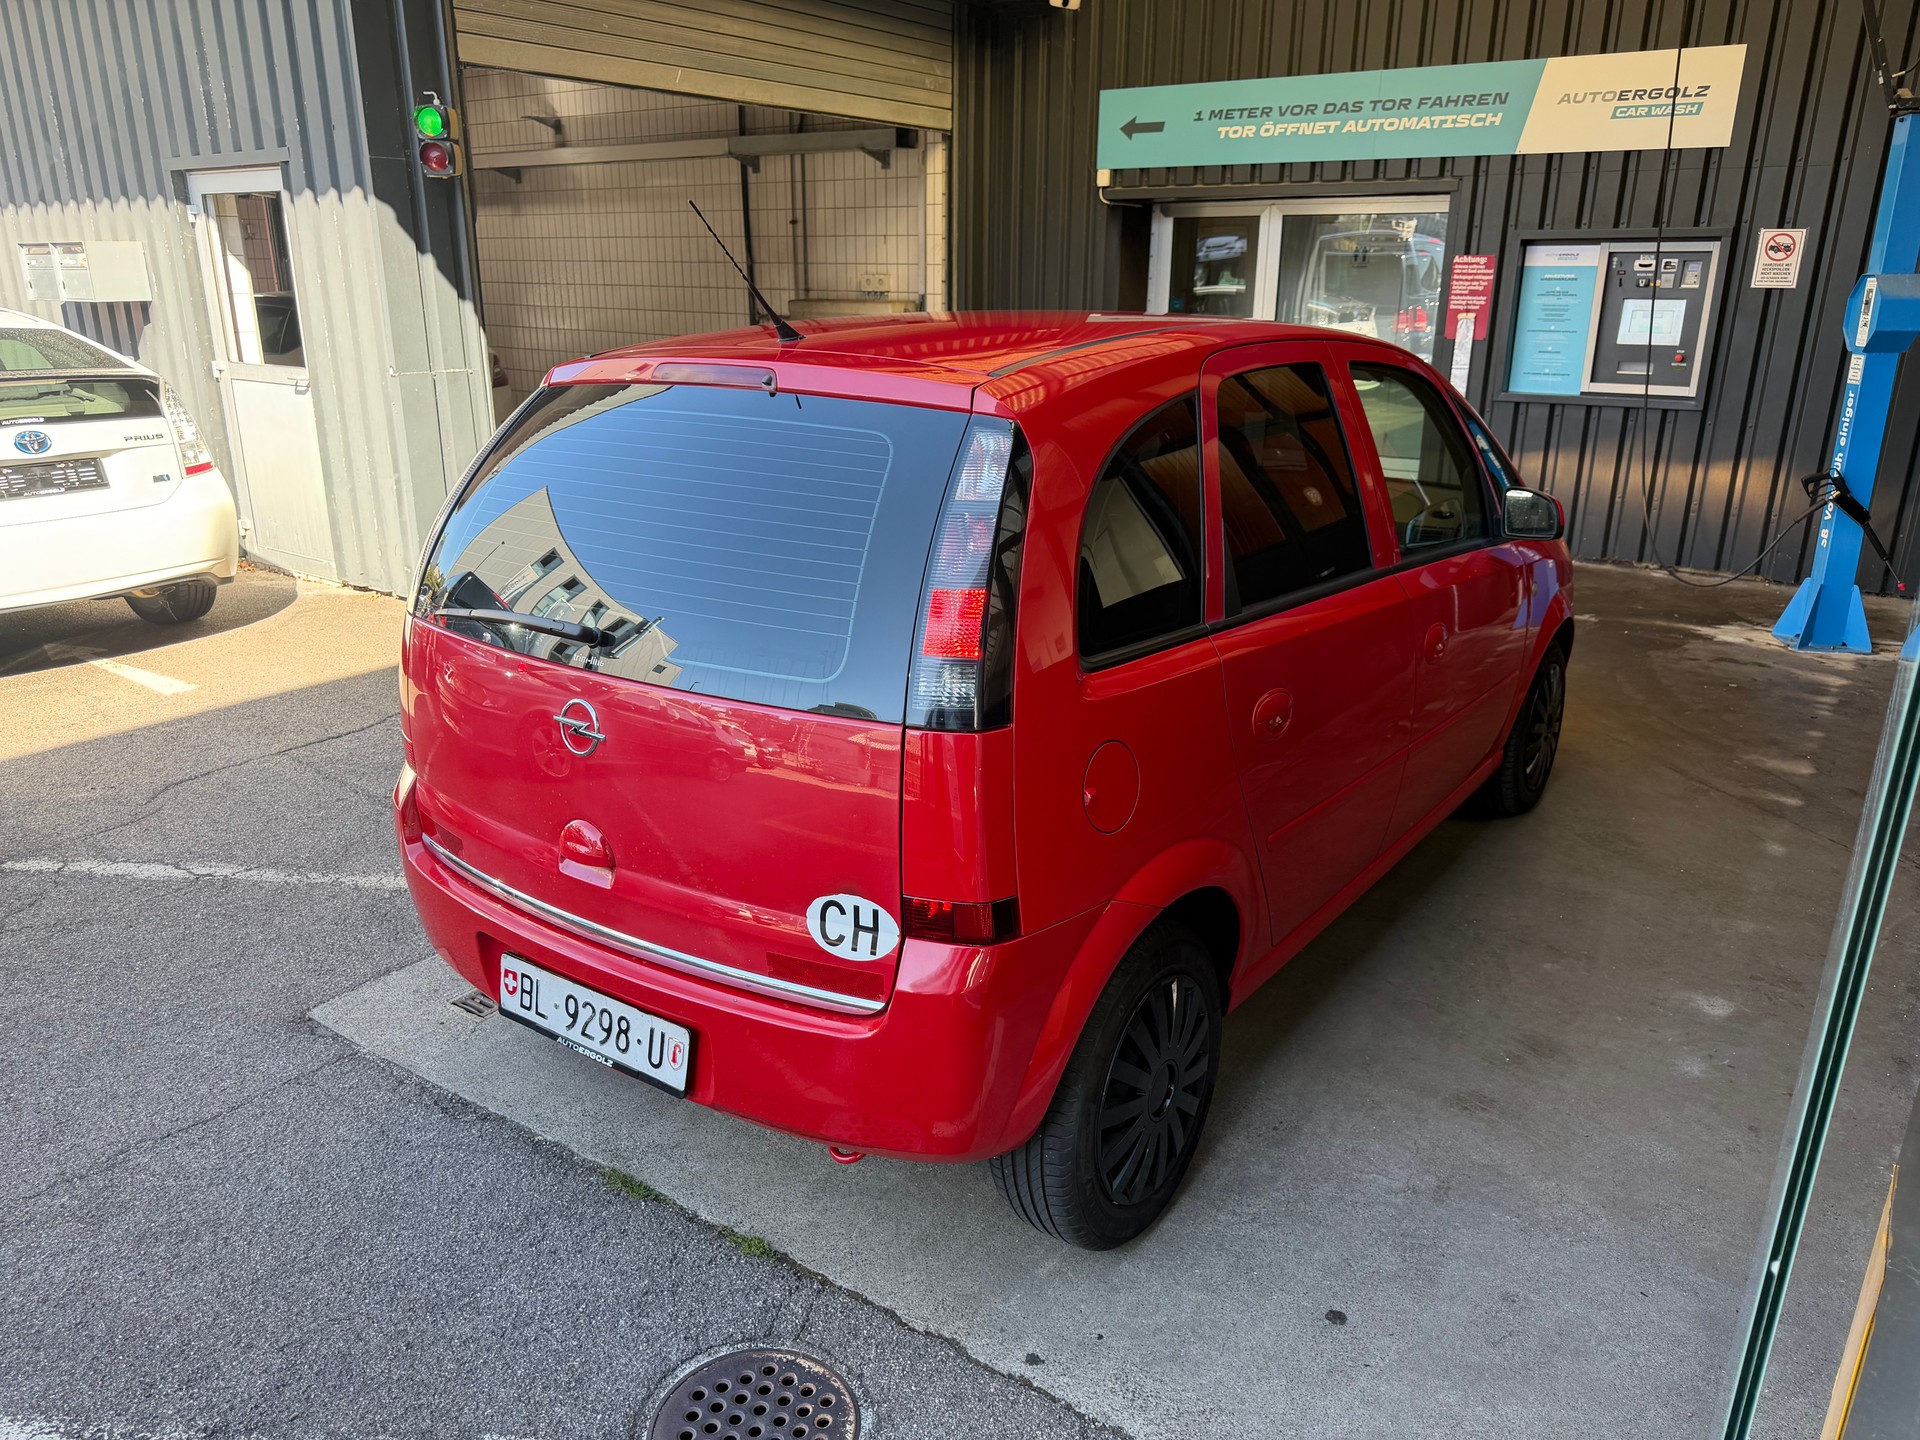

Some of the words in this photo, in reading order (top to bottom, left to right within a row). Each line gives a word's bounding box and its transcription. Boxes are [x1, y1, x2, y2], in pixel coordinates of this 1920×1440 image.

[1193, 110, 1204, 121] 1
[1208, 106, 1273, 121] METER
[1278, 104, 1318, 117] VOR
[1323, 101, 1364, 114] DAS
[1369, 98, 1412, 112] TOR
[1416, 92, 1510, 109] FAHREN
[1557, 85, 1711, 105] AUTOERGOLZ
[1616, 106, 1646, 117] CAR
[1651, 104, 1698, 115] WASH
[1217, 124, 1256, 139] TOR
[1260, 121, 1341, 137] ÖFFNET
[1342, 112, 1503, 133] AUTOMATISCH
[1453, 255, 1488, 265] Achtung:
[124, 433, 164, 442] PRIUS
[819, 900, 879, 956] CH
[520, 972, 549, 1020] BL
[565, 993, 631, 1054] 9298
[647, 1026, 666, 1069] U
[556, 1036, 614, 1067] AUTOERGOLZ
